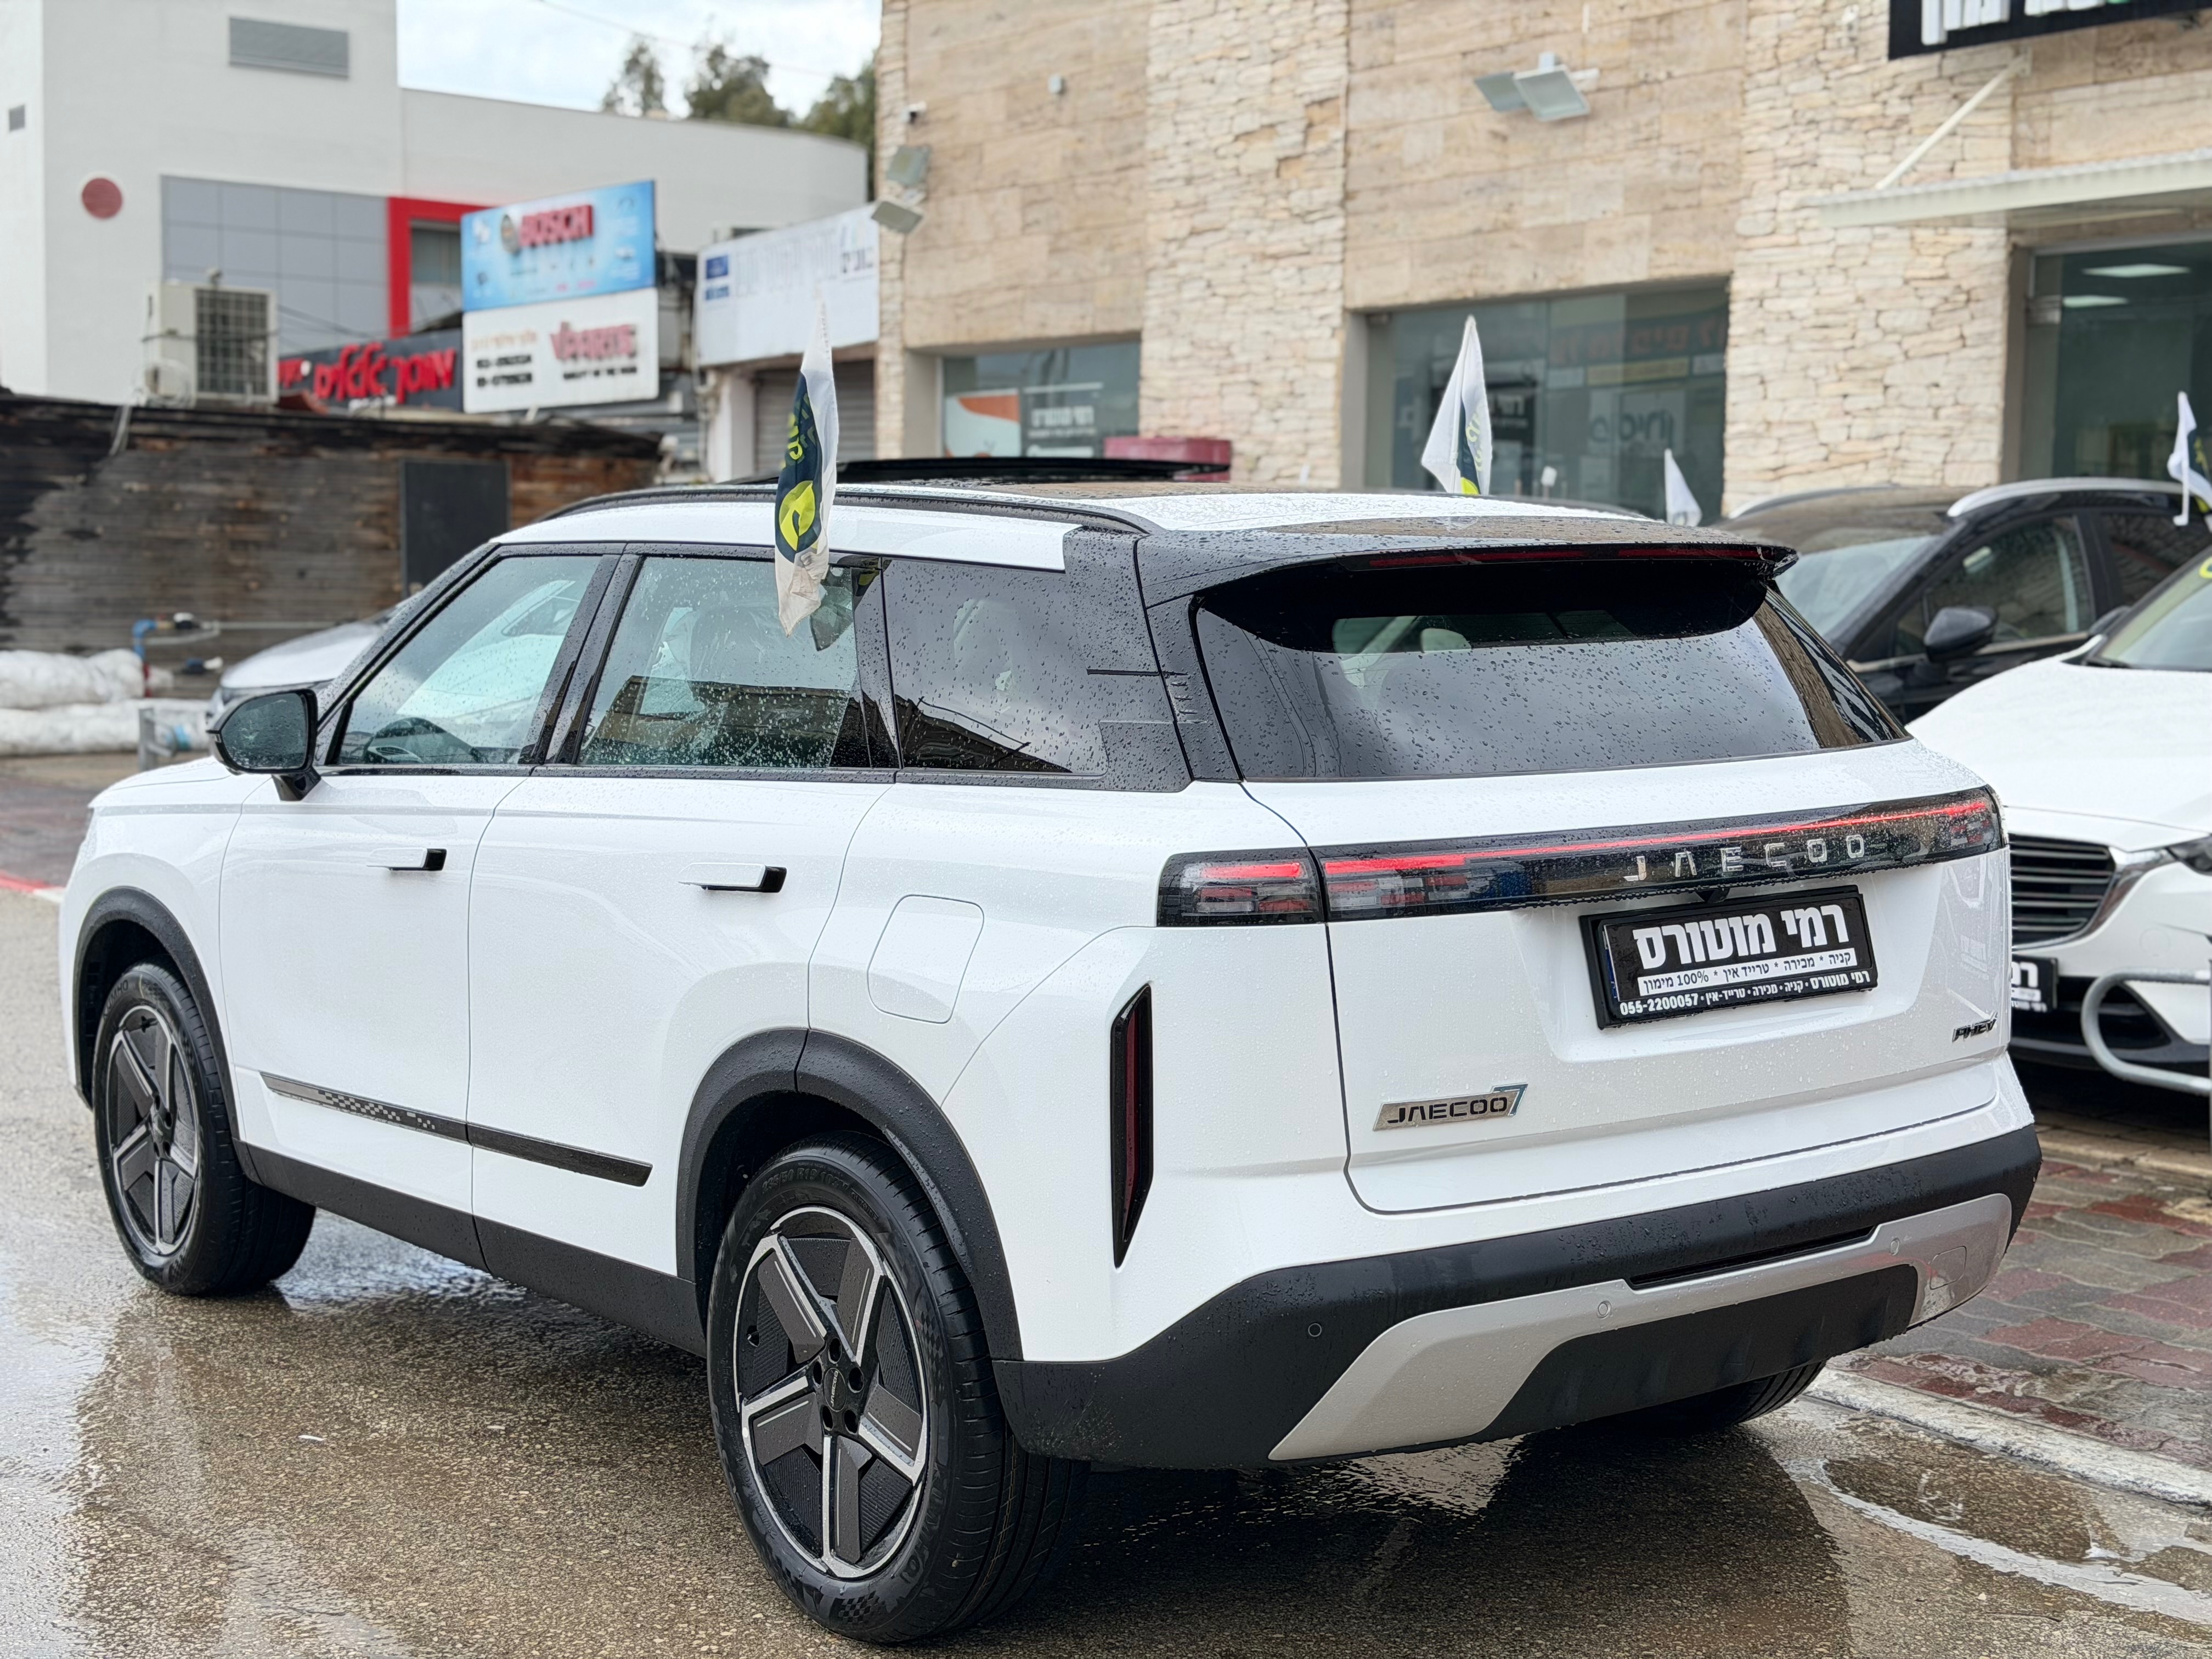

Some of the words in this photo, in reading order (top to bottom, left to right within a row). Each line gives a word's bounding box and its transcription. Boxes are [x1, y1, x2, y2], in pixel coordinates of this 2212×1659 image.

[1624, 834, 1865, 881] JAECOO
[1780, 904, 1849, 948] רמי
[1632, 913, 1777, 970] מוטורס
[1784, 957, 1814, 972] מכירה
[1829, 952, 1851, 966] קניה
[1677, 970, 1709, 986] 100%
[1723, 967, 1739, 983] אין
[1741, 963, 1769, 979] טרייד
[1851, 970, 1871, 984] רמי
[1643, 979, 1674, 994] מימון
[1785, 980, 1803, 994] קניה
[1810, 973, 1849, 989] מוטורס
[1752, 983, 1778, 996] מכירה
[1620, 993, 1699, 1015] 055-2200057
[1386, 1097, 1508, 1124] JAECOO
